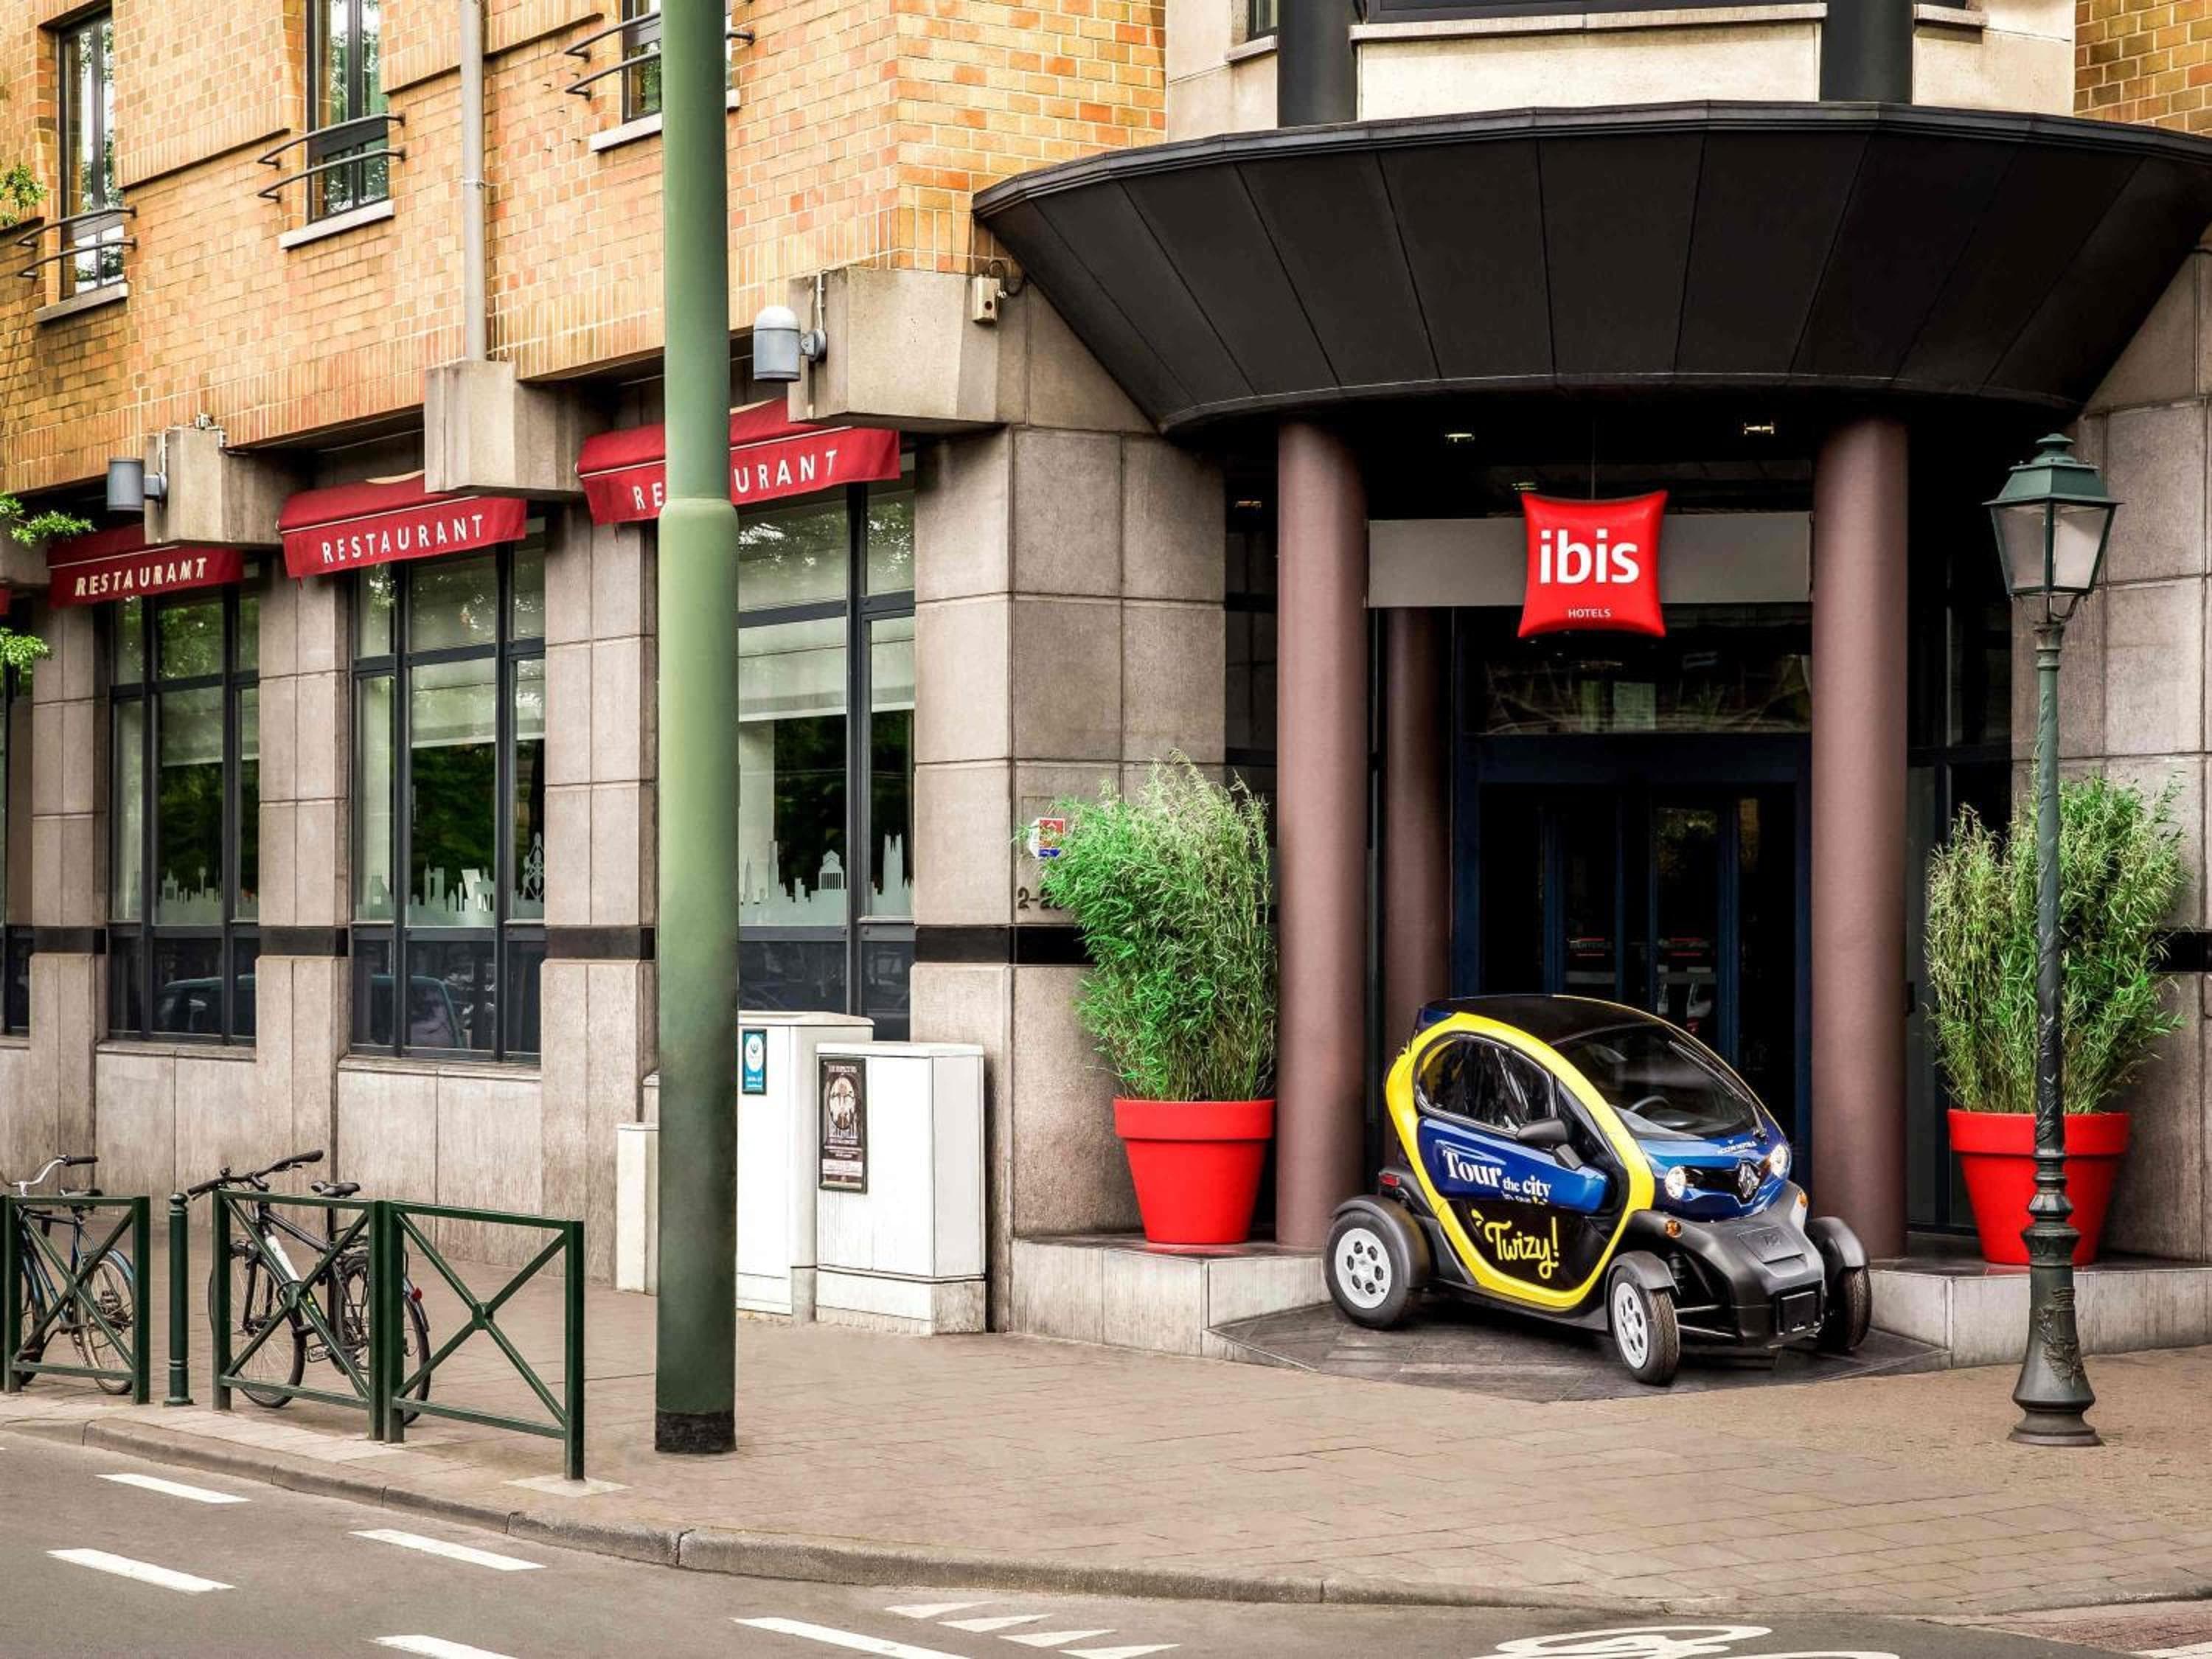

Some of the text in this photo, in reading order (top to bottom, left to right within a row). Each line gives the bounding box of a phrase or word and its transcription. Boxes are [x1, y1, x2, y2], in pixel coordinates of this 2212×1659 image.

[632, 449, 838, 511] REURANT
[321, 514, 484, 564] RESTAURANT
[1540, 528, 1640, 584] ibis
[74, 557, 207, 597] RESTAURANT
[1568, 608, 1612, 619] HOTELS
[1442, 1149, 1502, 1188] Tour
[1502, 1176, 1521, 1192] the
[1523, 1174, 1551, 1197] city
[1484, 1216, 1559, 1279] Twizy!
